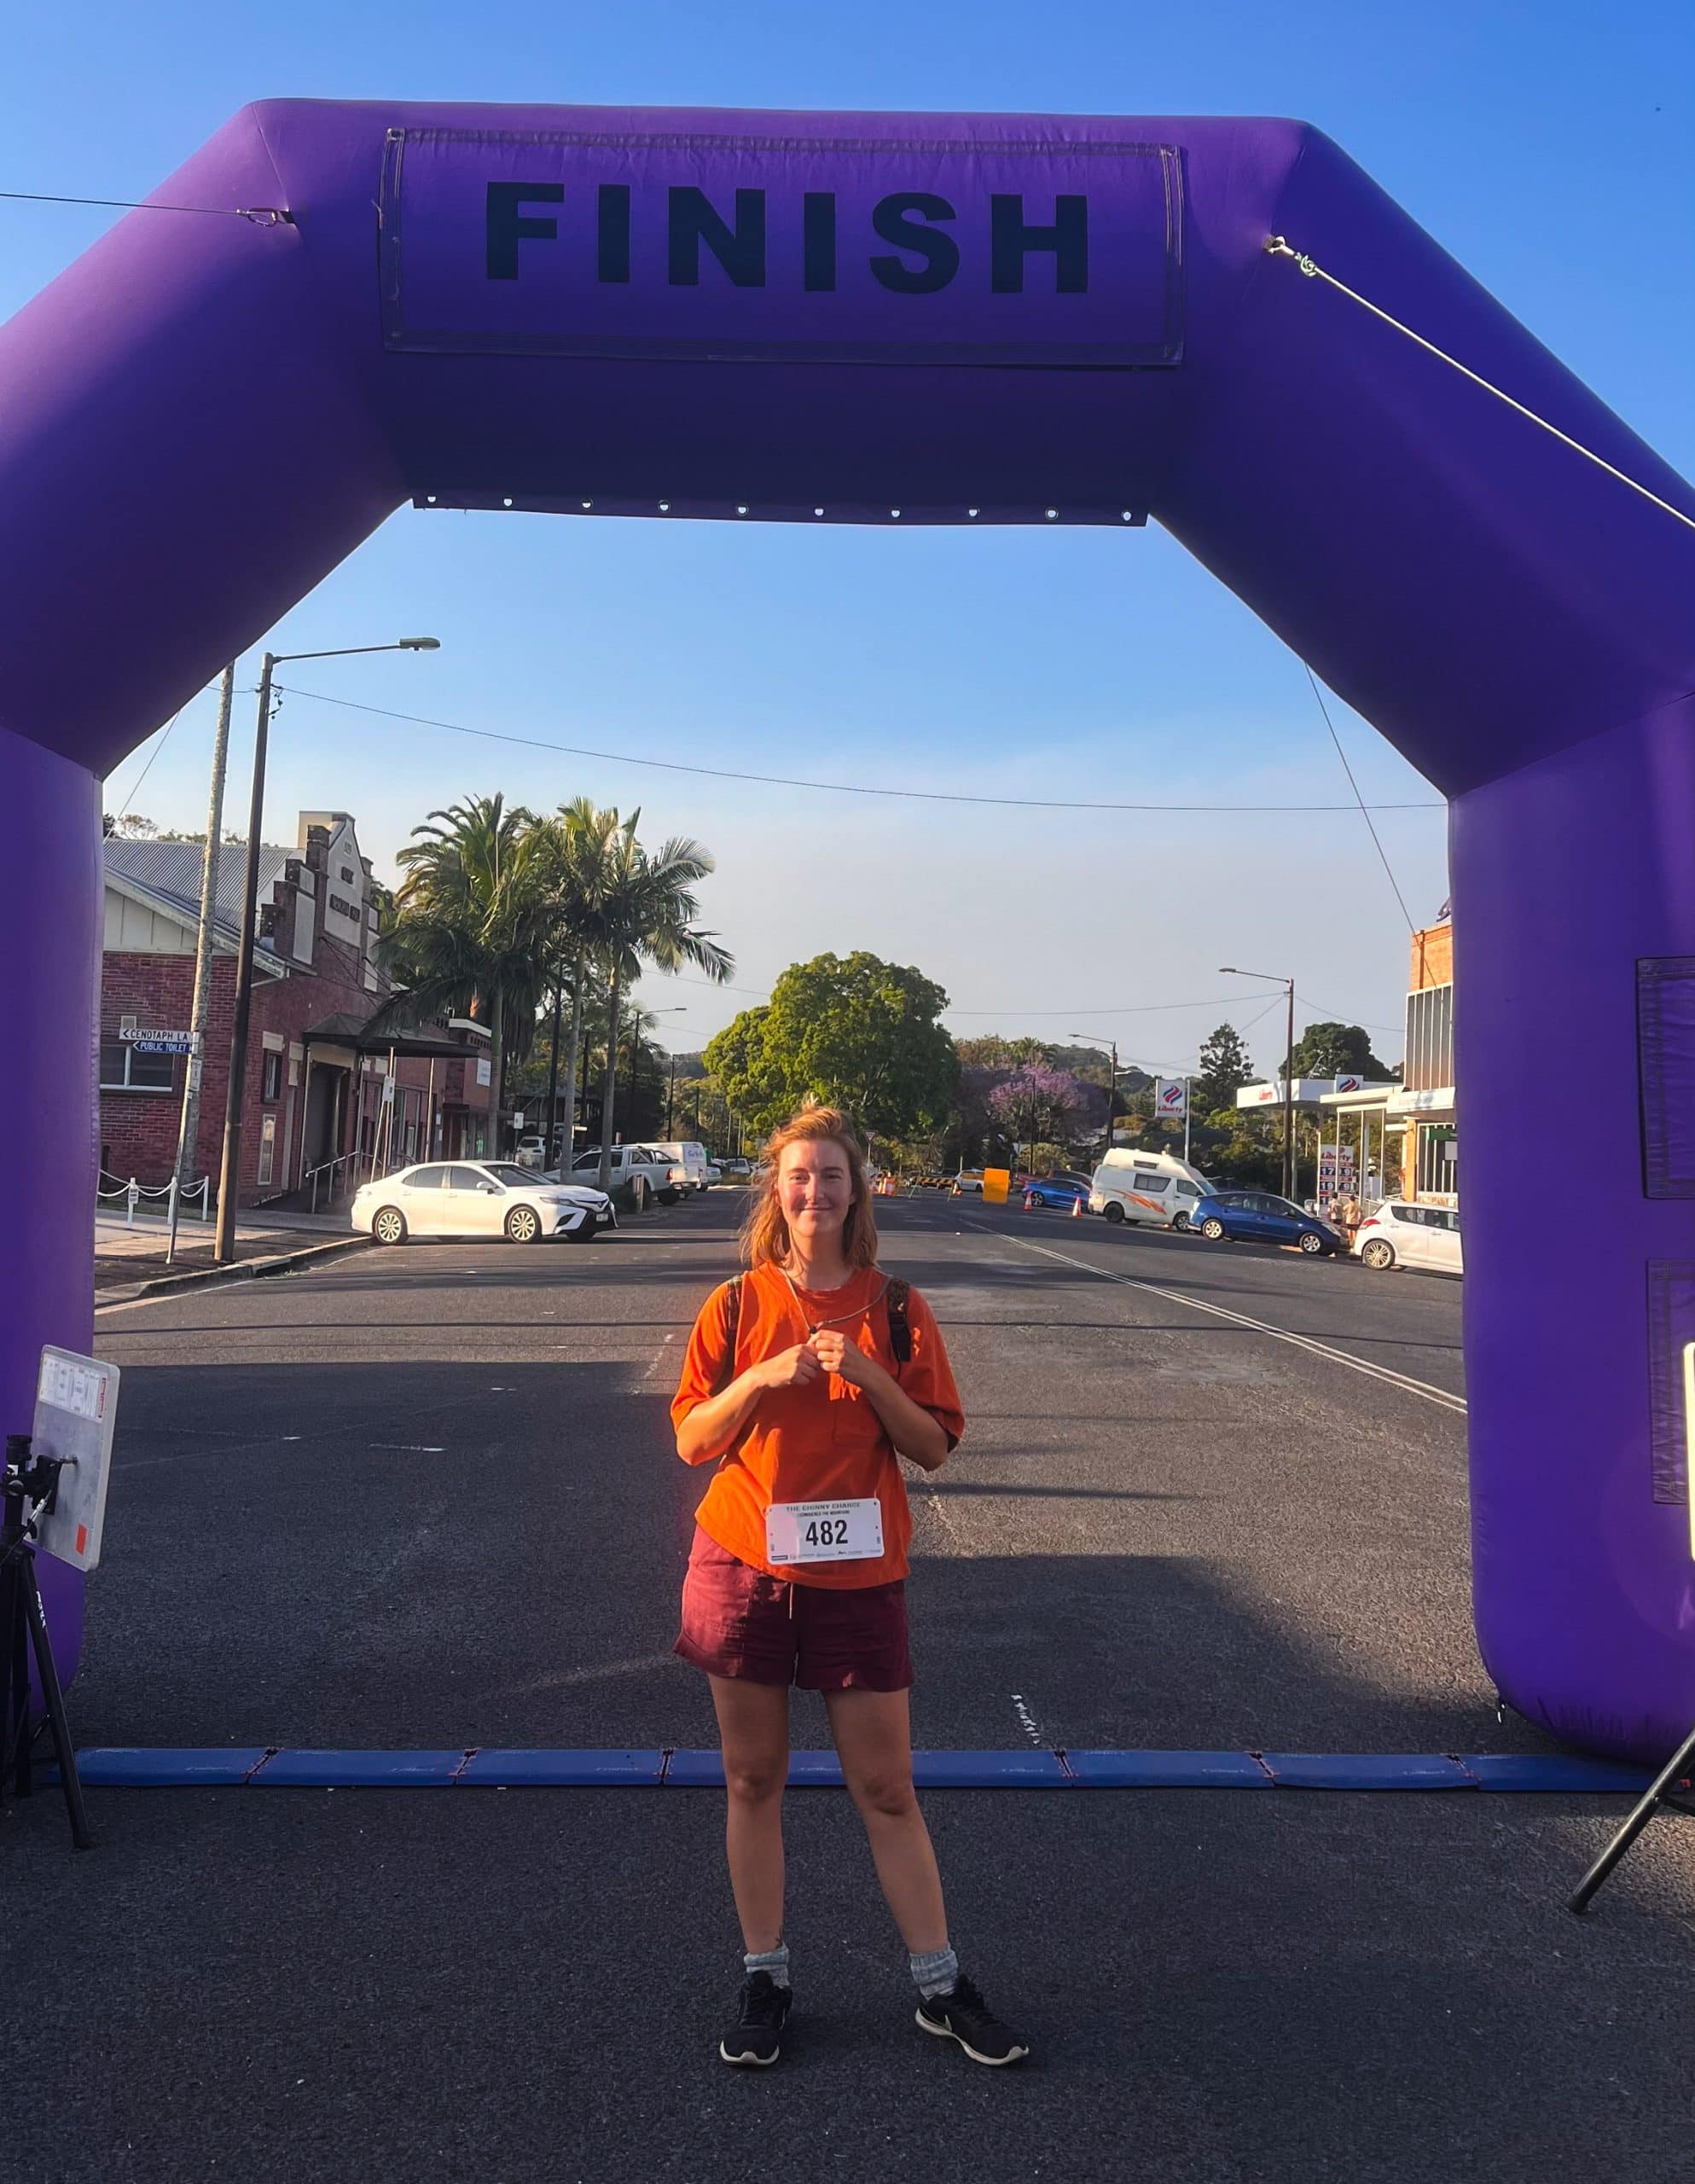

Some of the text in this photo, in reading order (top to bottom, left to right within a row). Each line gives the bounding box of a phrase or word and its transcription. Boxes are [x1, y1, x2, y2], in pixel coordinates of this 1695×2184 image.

[486, 180, 1088, 294] FINISH
[131, 1029, 188, 1041] CENOTAPH LA
[140, 1042, 187, 1052] PUBLIC TOILET
[805, 1519, 849, 1546] 482
